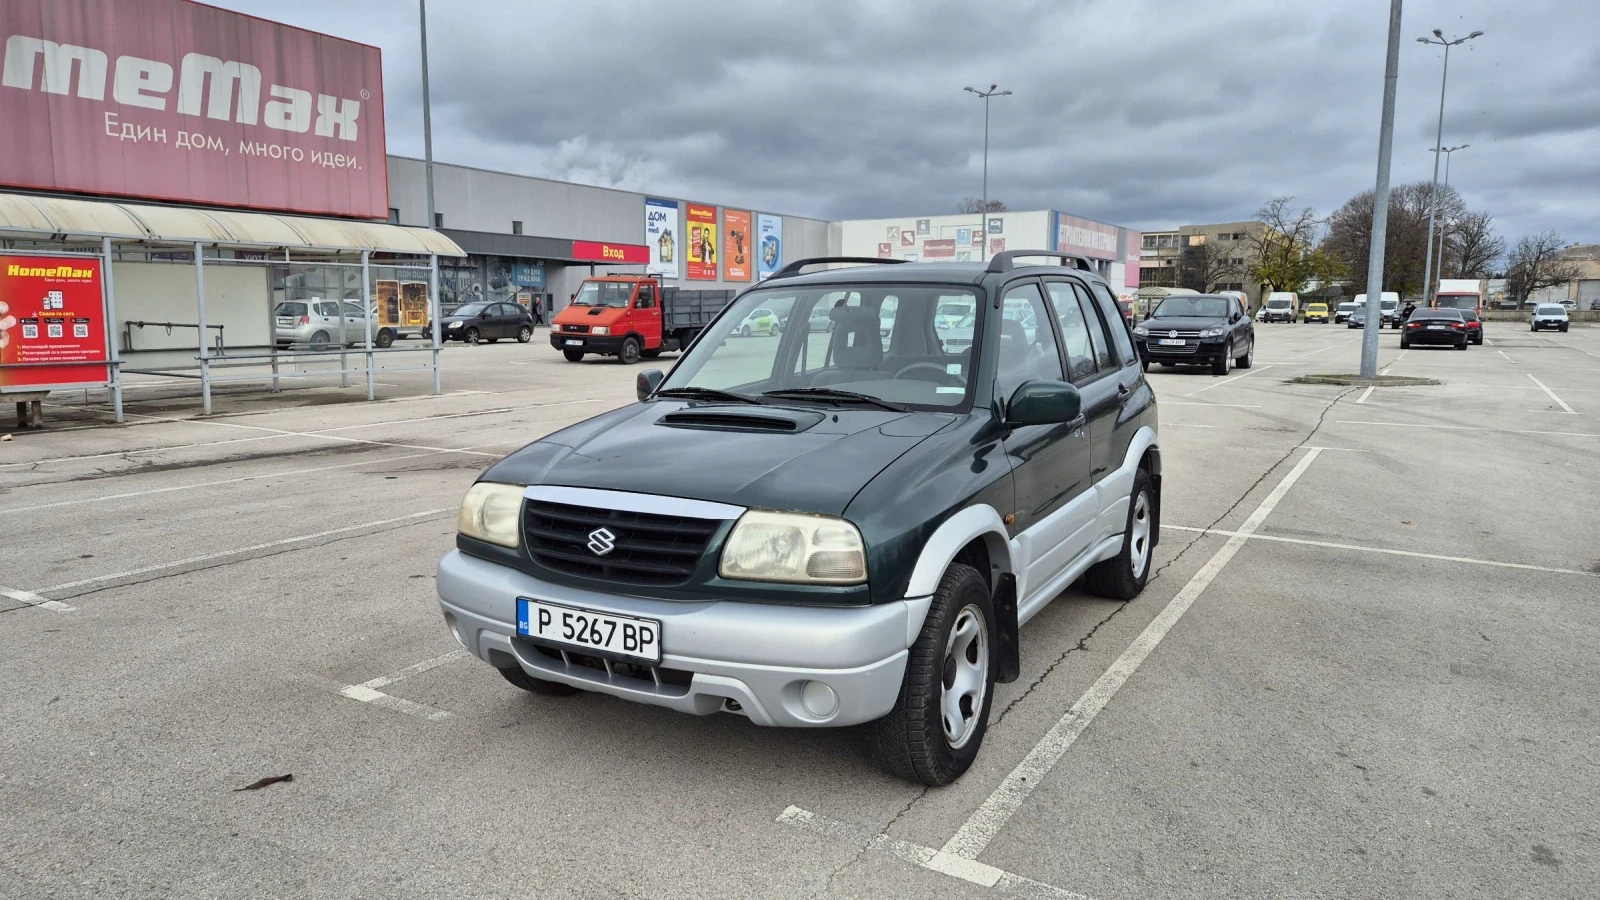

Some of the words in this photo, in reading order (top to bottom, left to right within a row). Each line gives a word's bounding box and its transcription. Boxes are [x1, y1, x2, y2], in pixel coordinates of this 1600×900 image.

[104, 111, 167, 143] Един
[175, 130, 230, 156] дом,
[239, 140, 304, 162] много
[311, 149, 362, 170] идеи.
[602, 245, 625, 260] Вход
[7, 264, 93, 278] HomeMax
[519, 620, 528, 630] BG
[538, 608, 551, 634] P
[562, 612, 617, 648] 5267
[623, 623, 654, 653] BP
